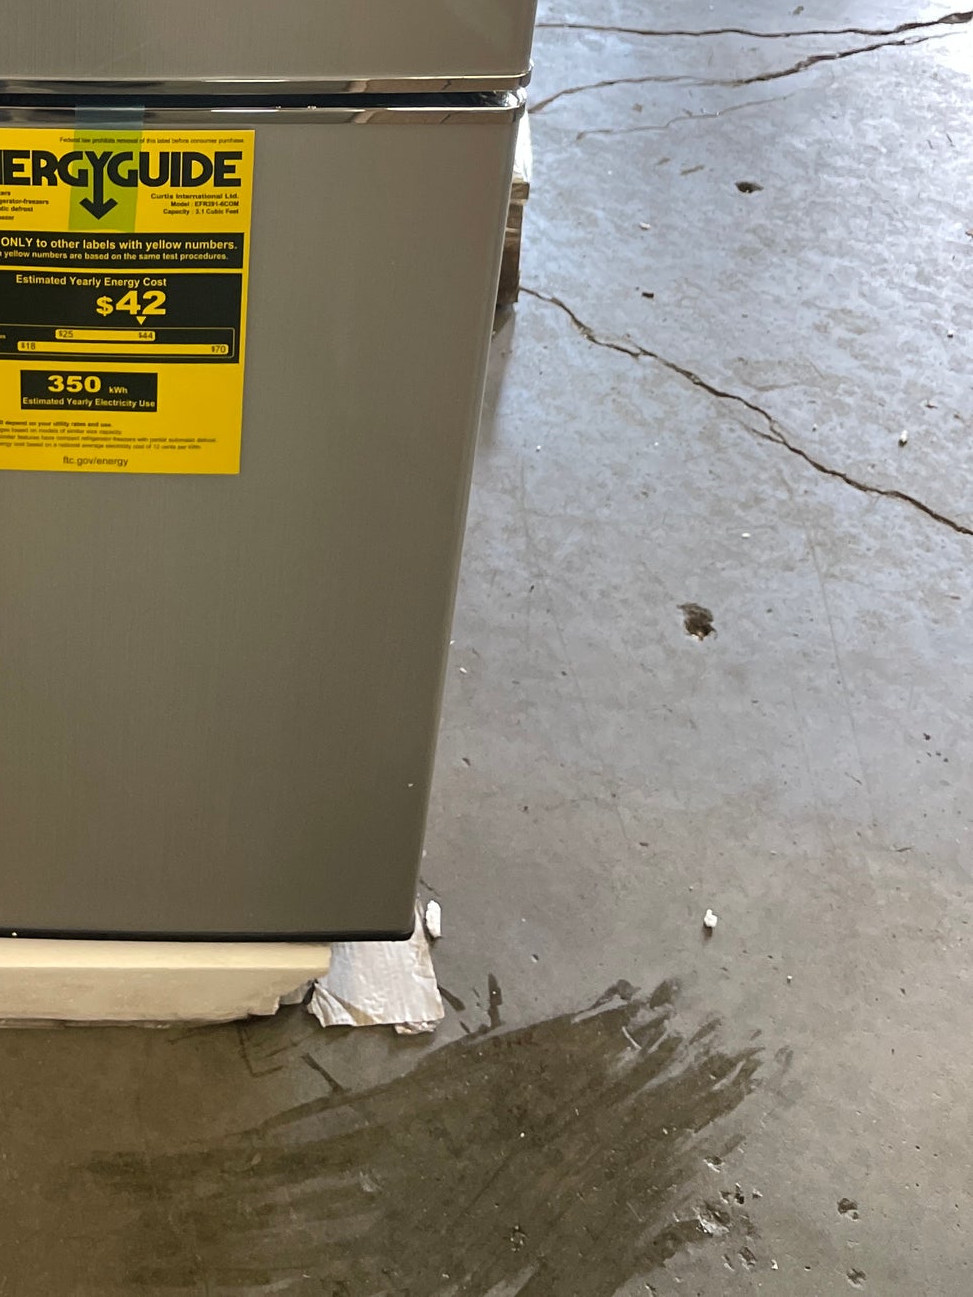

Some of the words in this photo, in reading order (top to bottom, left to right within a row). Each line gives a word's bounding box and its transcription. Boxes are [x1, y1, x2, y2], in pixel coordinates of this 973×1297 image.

[150, 192, 174, 200] Curtis
[176, 192, 223, 200] International
[224, 192, 239, 200] Ltd.
[170, 200, 190, 208] Model
[163, 208, 190, 216] Capacity
[0, 236, 33, 248] ONLY
[36, 238, 48, 249] to
[50, 238, 80, 249] other
[83, 239, 116, 250] labels
[119, 239, 143, 250] with
[145, 239, 182, 252] yellow
[185, 239, 238, 251] numbers.
[4, 249, 30, 259] yellow
[32, 250, 67, 259] numbers
[69, 252, 83, 260] are
[84, 251, 109, 260] based
[123, 252, 136, 260] the
[138, 253, 161, 261] same
[162, 252, 178, 261] test
[180, 252, 229, 262] procedures.
[15, 274, 67, 286] Estimated
[69, 275, 101, 289] Yearly
[104, 276, 140, 289] Energy
[142, 277, 167, 287] Cost
[96, 290, 166, 317] $42
[58, 330, 74, 339] $25
[138, 332, 153, 340] $44
[20, 342, 36, 350] $18
[210, 344, 227, 353] $70
[47, 375, 101, 393] 350
[109, 386, 128, 395] kWh
[22, 396, 65, 406] Estimated
[66, 397, 93, 408] Yearly
[94, 398, 137, 409] Electricity
[138, 399, 156, 408] Use
[63, 455, 129, 468] ftc.gov/energy
